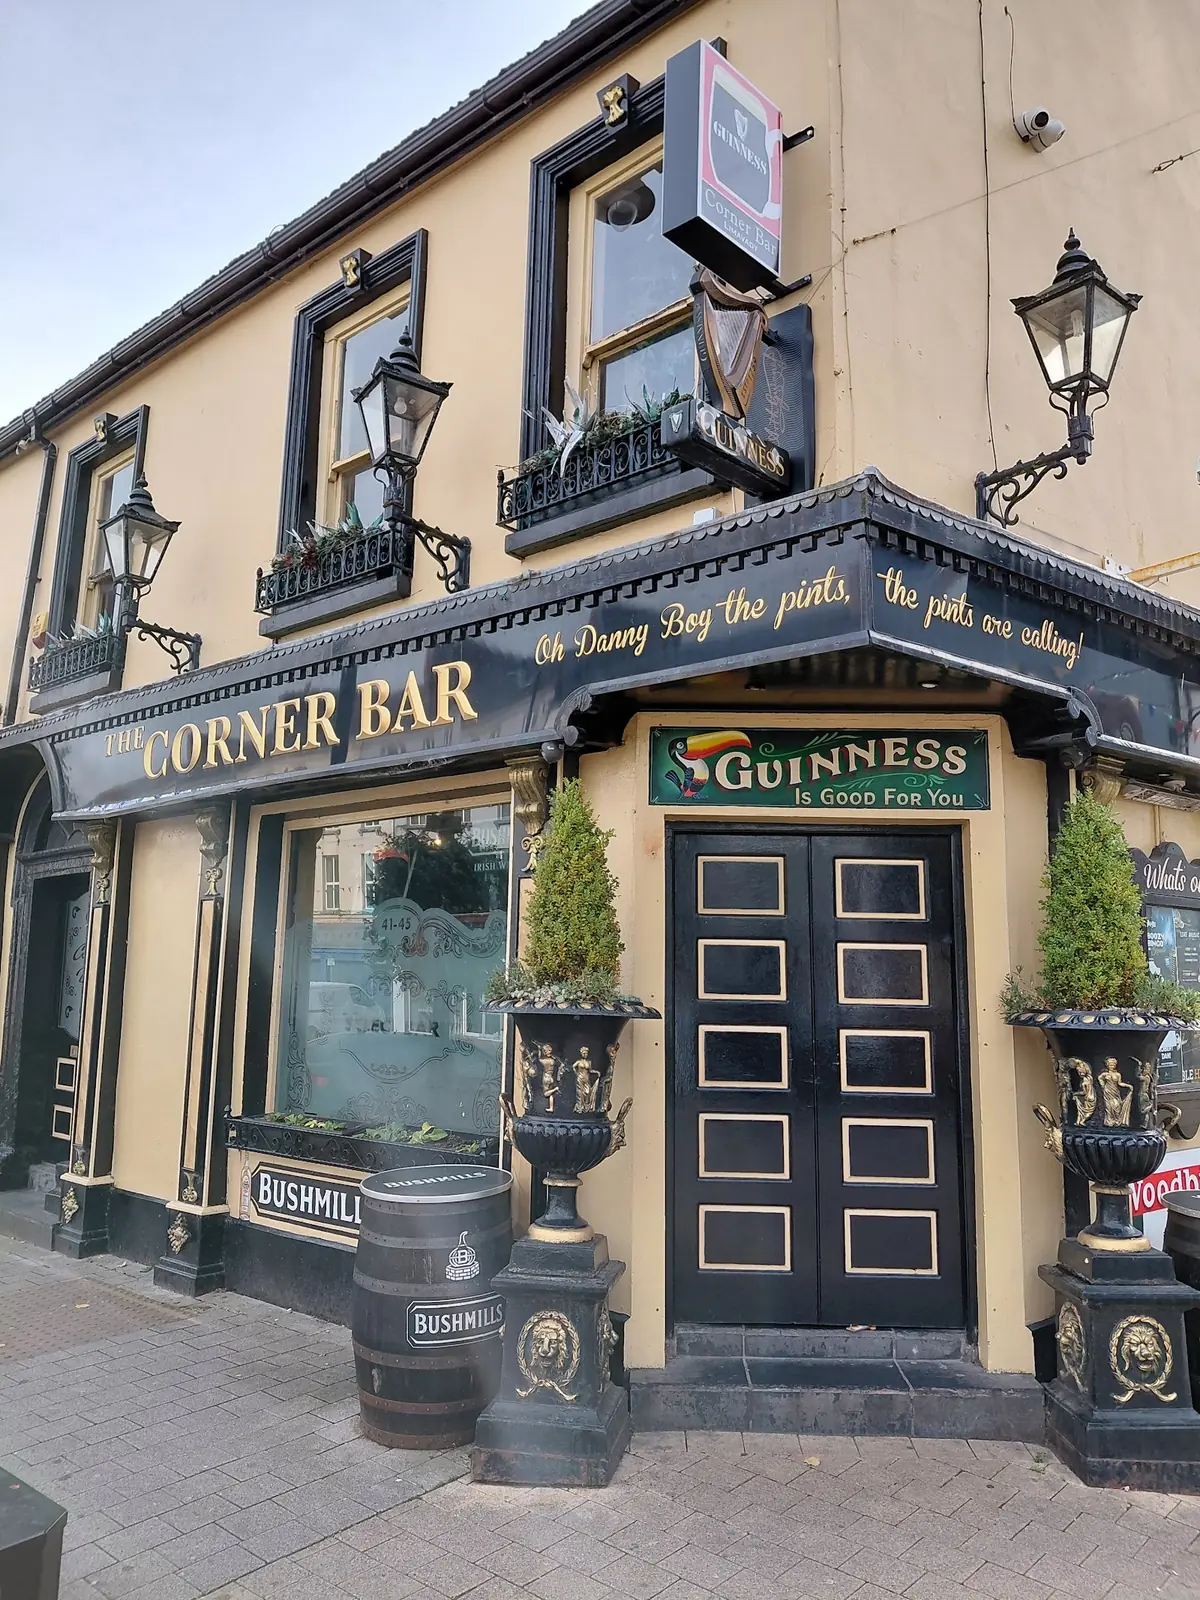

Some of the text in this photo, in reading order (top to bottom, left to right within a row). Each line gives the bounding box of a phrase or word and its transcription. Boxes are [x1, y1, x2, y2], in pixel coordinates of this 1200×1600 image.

[713, 120, 767, 175] GUINNESS
[705, 188, 778, 255] Corner Bar
[697, 409, 785, 477] GUINNESS
[534, 565, 850, 665] Oh Danny Boy the pints,
[876, 566, 1084, 670] the pints are calling!
[104, 660, 479, 780] THE CORNER BAR
[714, 737, 967, 790] GUINNESS
[473, 862, 496, 872] IRISH
[381, 917, 412, 931] 41-45
[383, 1171, 486, 1188] BUSHMILLS
[414, 1303, 503, 1334] BUSHMILLS
